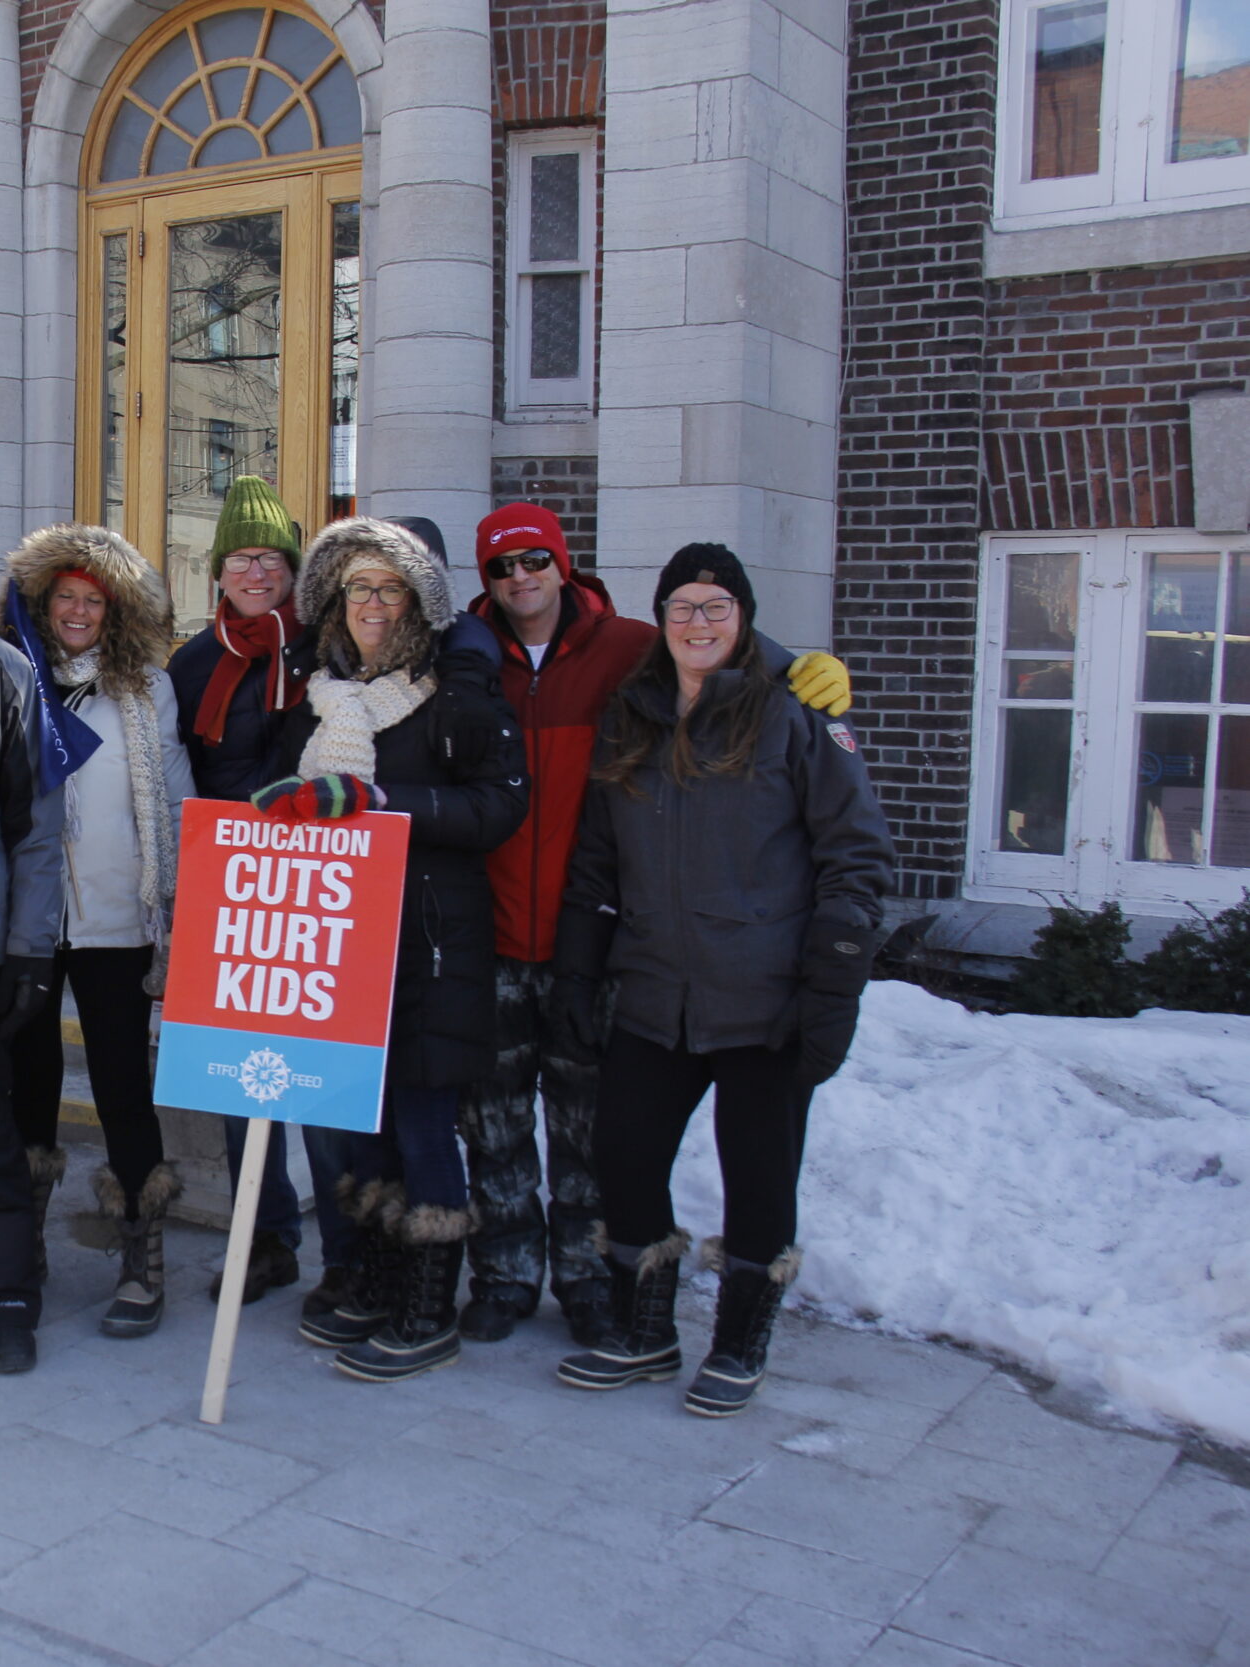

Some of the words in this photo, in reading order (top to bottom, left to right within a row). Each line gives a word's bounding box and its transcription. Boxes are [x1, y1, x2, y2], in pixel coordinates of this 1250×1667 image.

[215, 818, 371, 858] EDUCATION
[224, 853, 353, 911] CUTS
[213, 906, 354, 966] HURT
[214, 961, 336, 1021] KIDS
[207, 1062, 238, 1078] ETFO
[290, 1073, 322, 1089] FEEO
